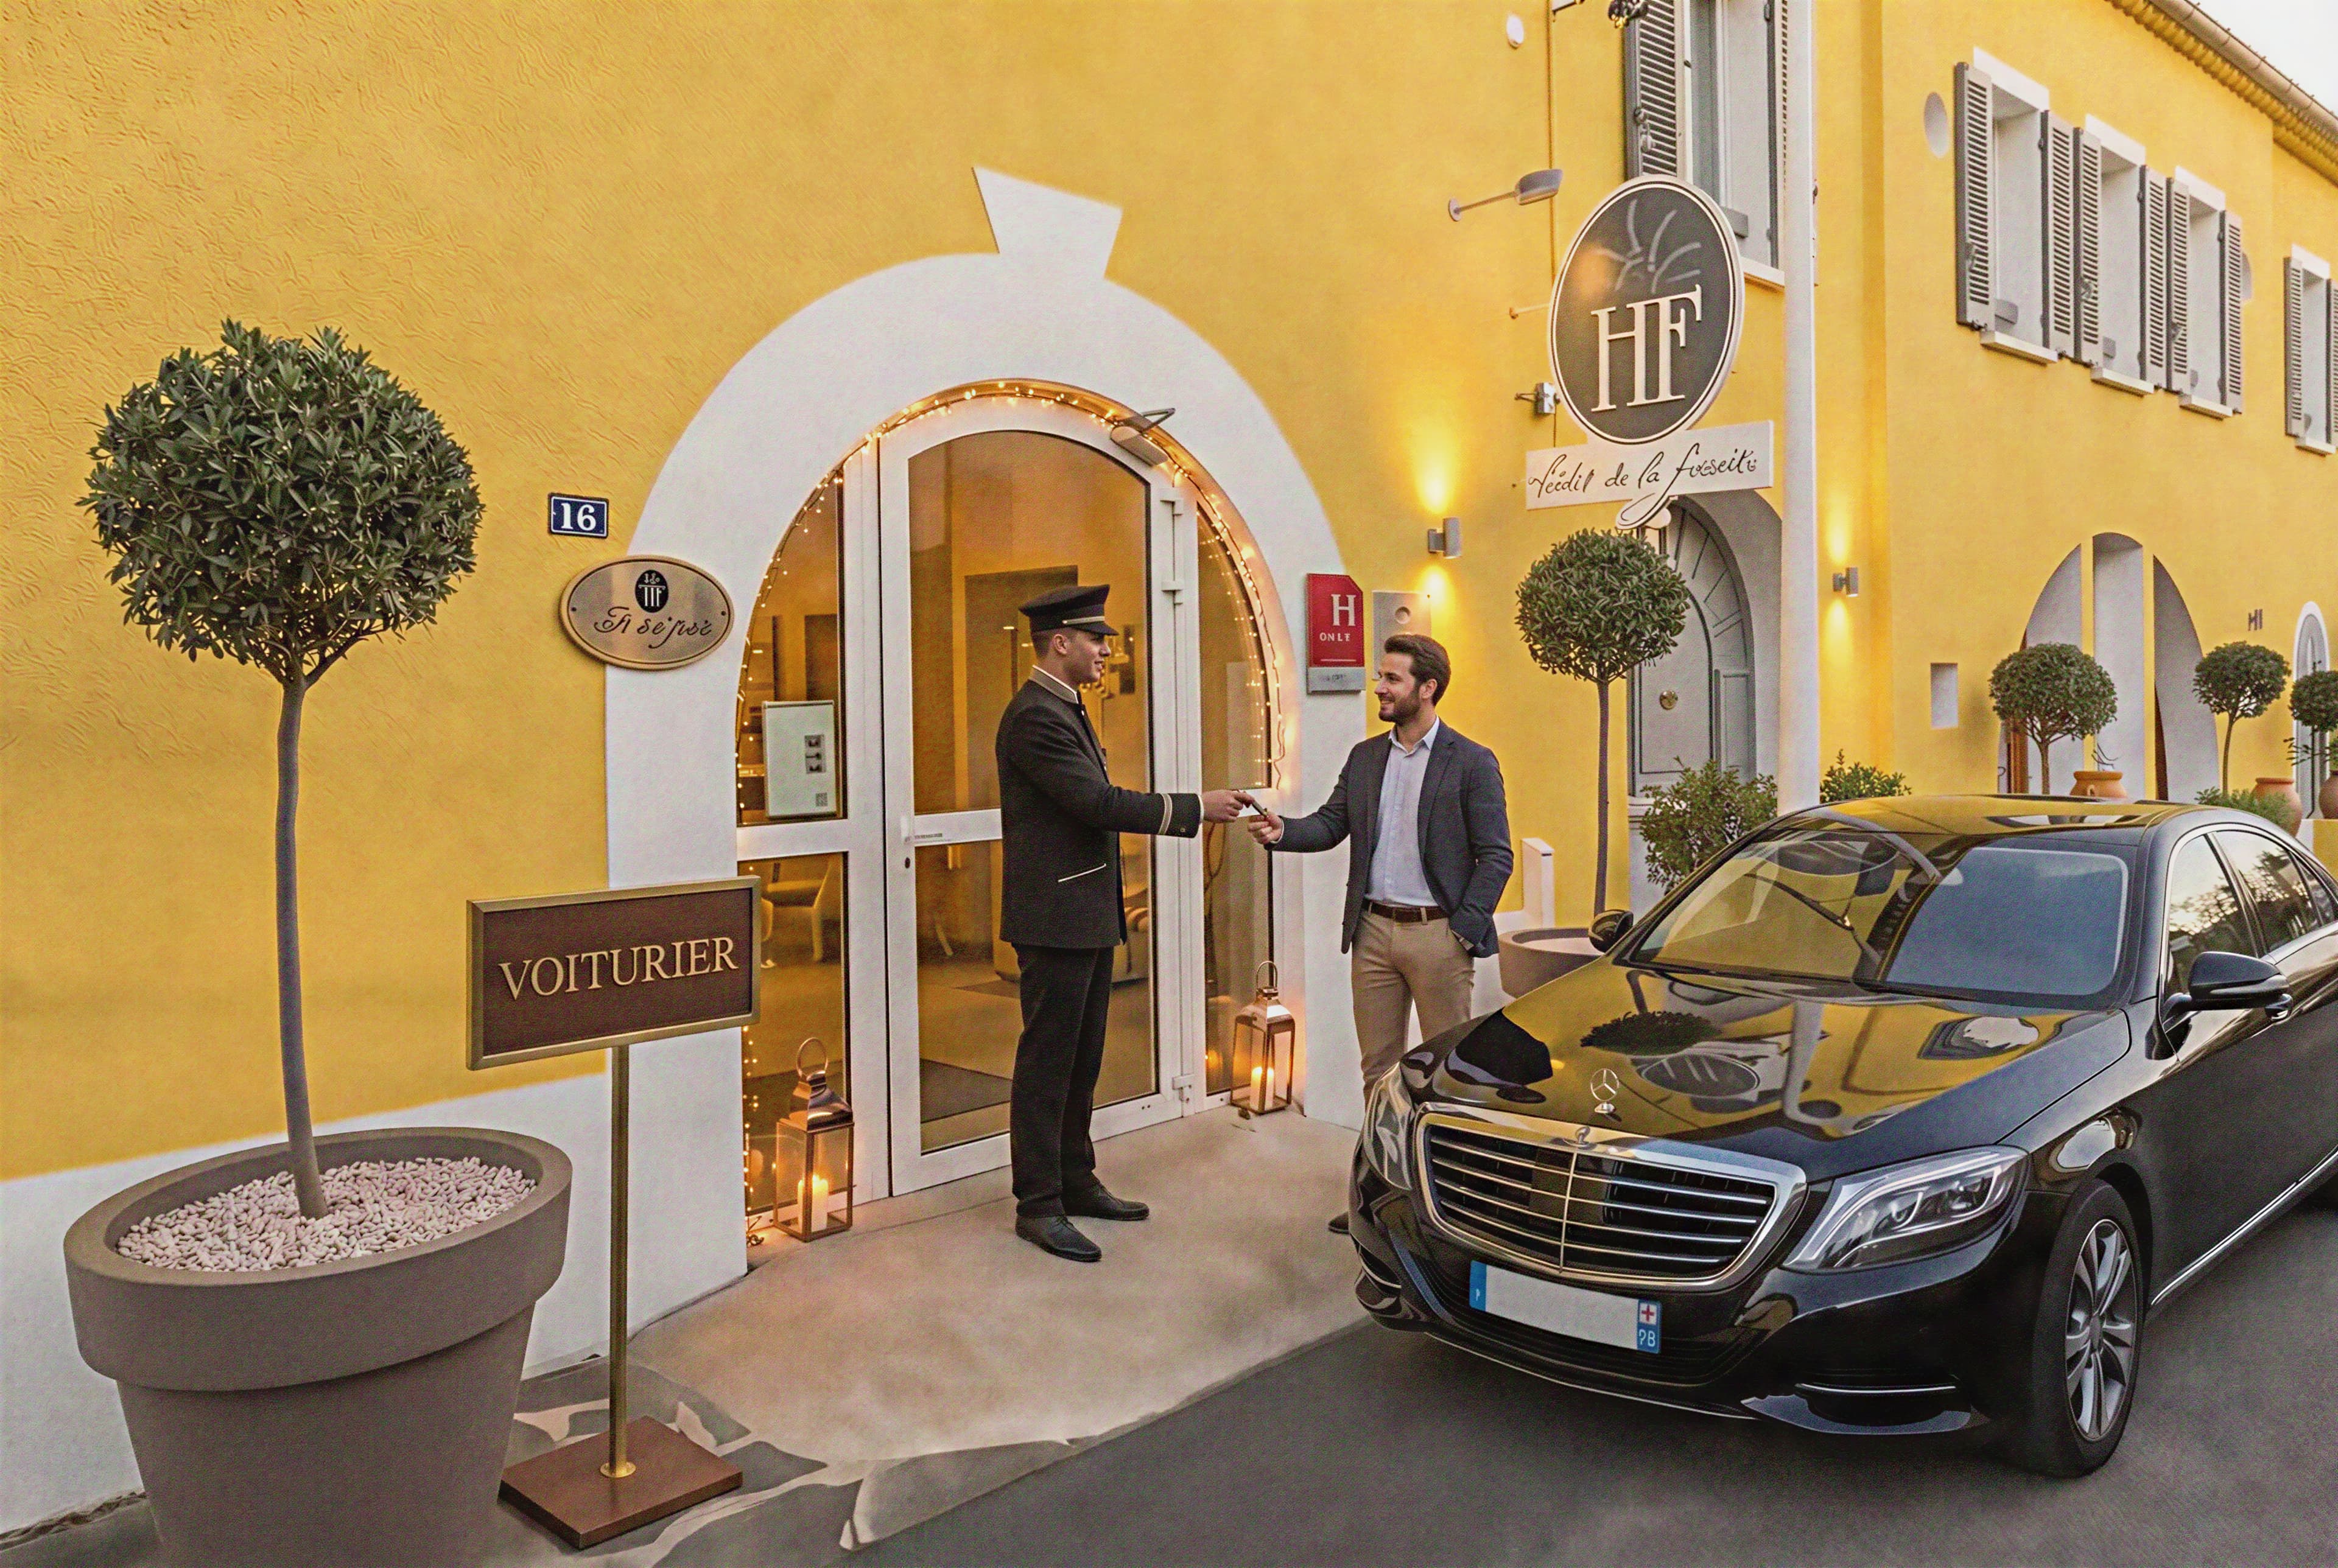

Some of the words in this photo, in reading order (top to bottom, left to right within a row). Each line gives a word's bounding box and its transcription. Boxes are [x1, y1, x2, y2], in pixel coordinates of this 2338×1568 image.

[1590, 284, 1702, 412] HF
[1605, 463, 1629, 486] de
[1638, 452, 1663, 489] la
[561, 503, 597, 531] 16
[1331, 593, 1357, 626] H
[498, 937, 739, 1001] VOITURIER
